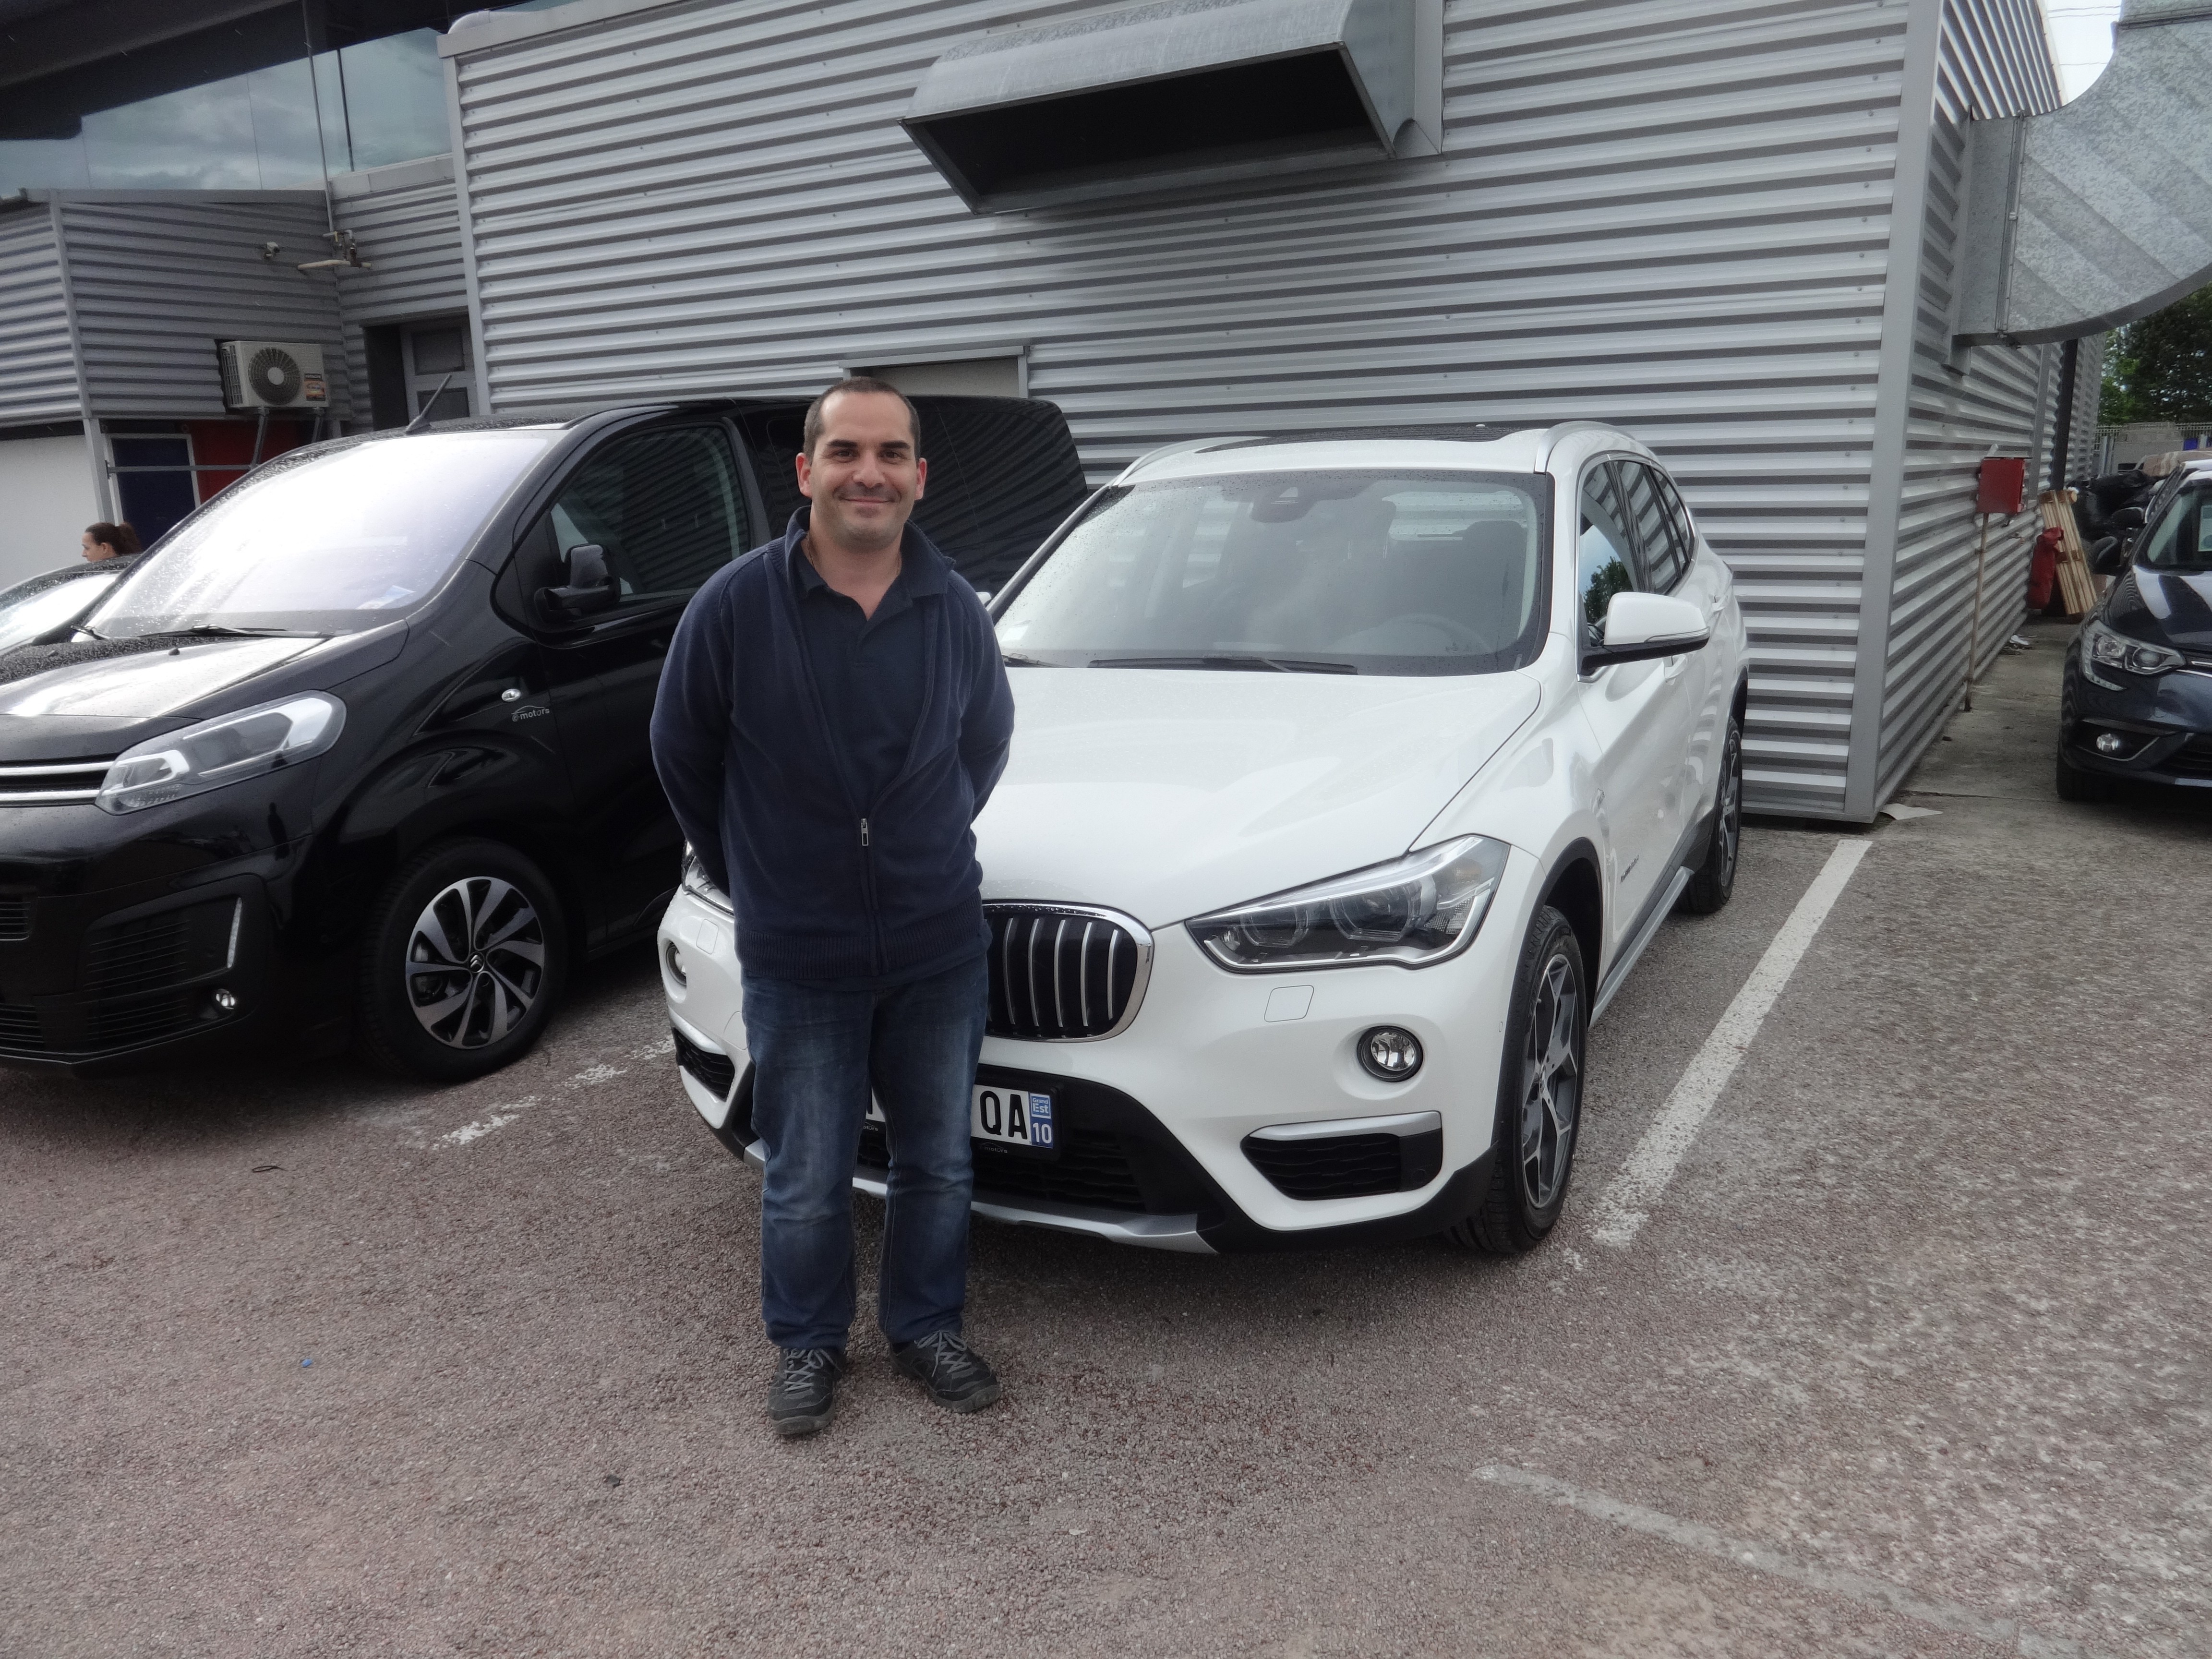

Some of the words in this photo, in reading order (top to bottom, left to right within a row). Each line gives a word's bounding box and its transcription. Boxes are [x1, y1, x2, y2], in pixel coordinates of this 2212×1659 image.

[980, 1091, 1028, 1140] QA
[1033, 1103, 1049, 1114] Est
[1033, 1123, 1052, 1143] 10
